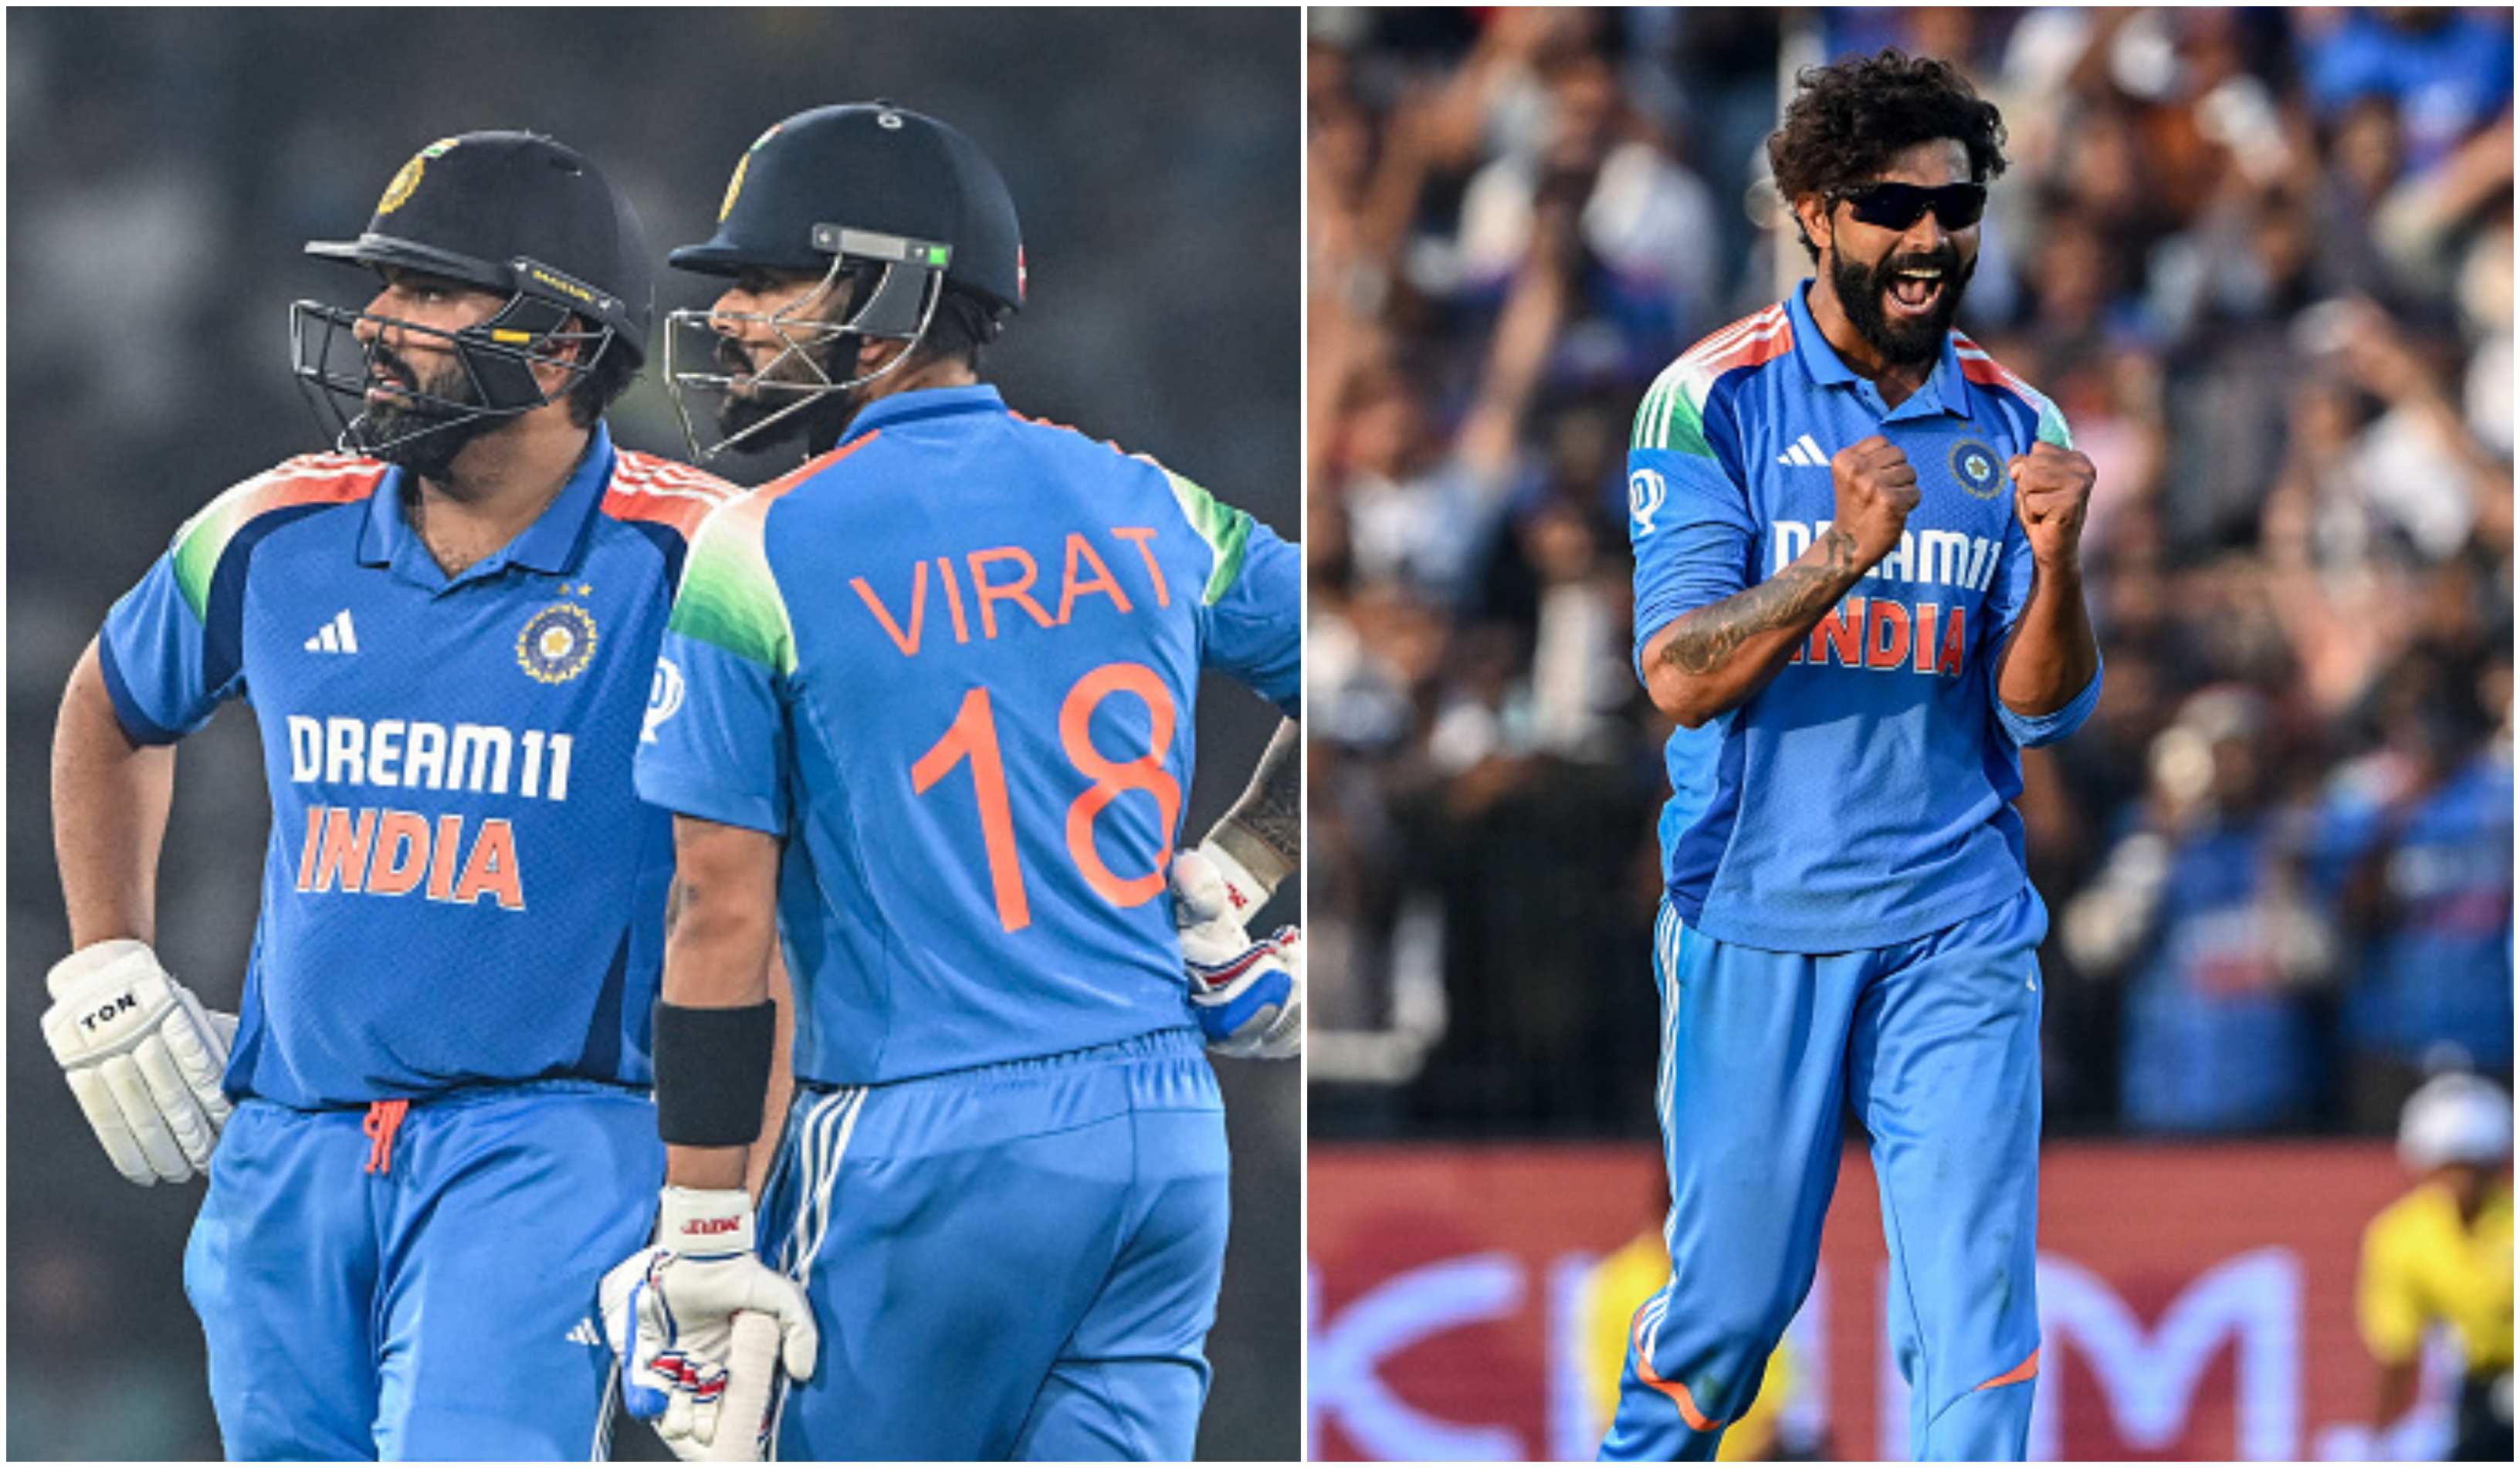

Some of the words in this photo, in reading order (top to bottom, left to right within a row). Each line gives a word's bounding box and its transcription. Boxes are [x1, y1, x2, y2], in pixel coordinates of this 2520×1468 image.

[849, 527, 1171, 657] VIRAT
[1770, 521, 2003, 592] DAM11
[1787, 596, 1966, 678] NDIA
[286, 715, 574, 801] DREAM11
[911, 661, 1181, 933] 18
[296, 804, 526, 911] INDIA
[80, 993, 136, 1030] TON
